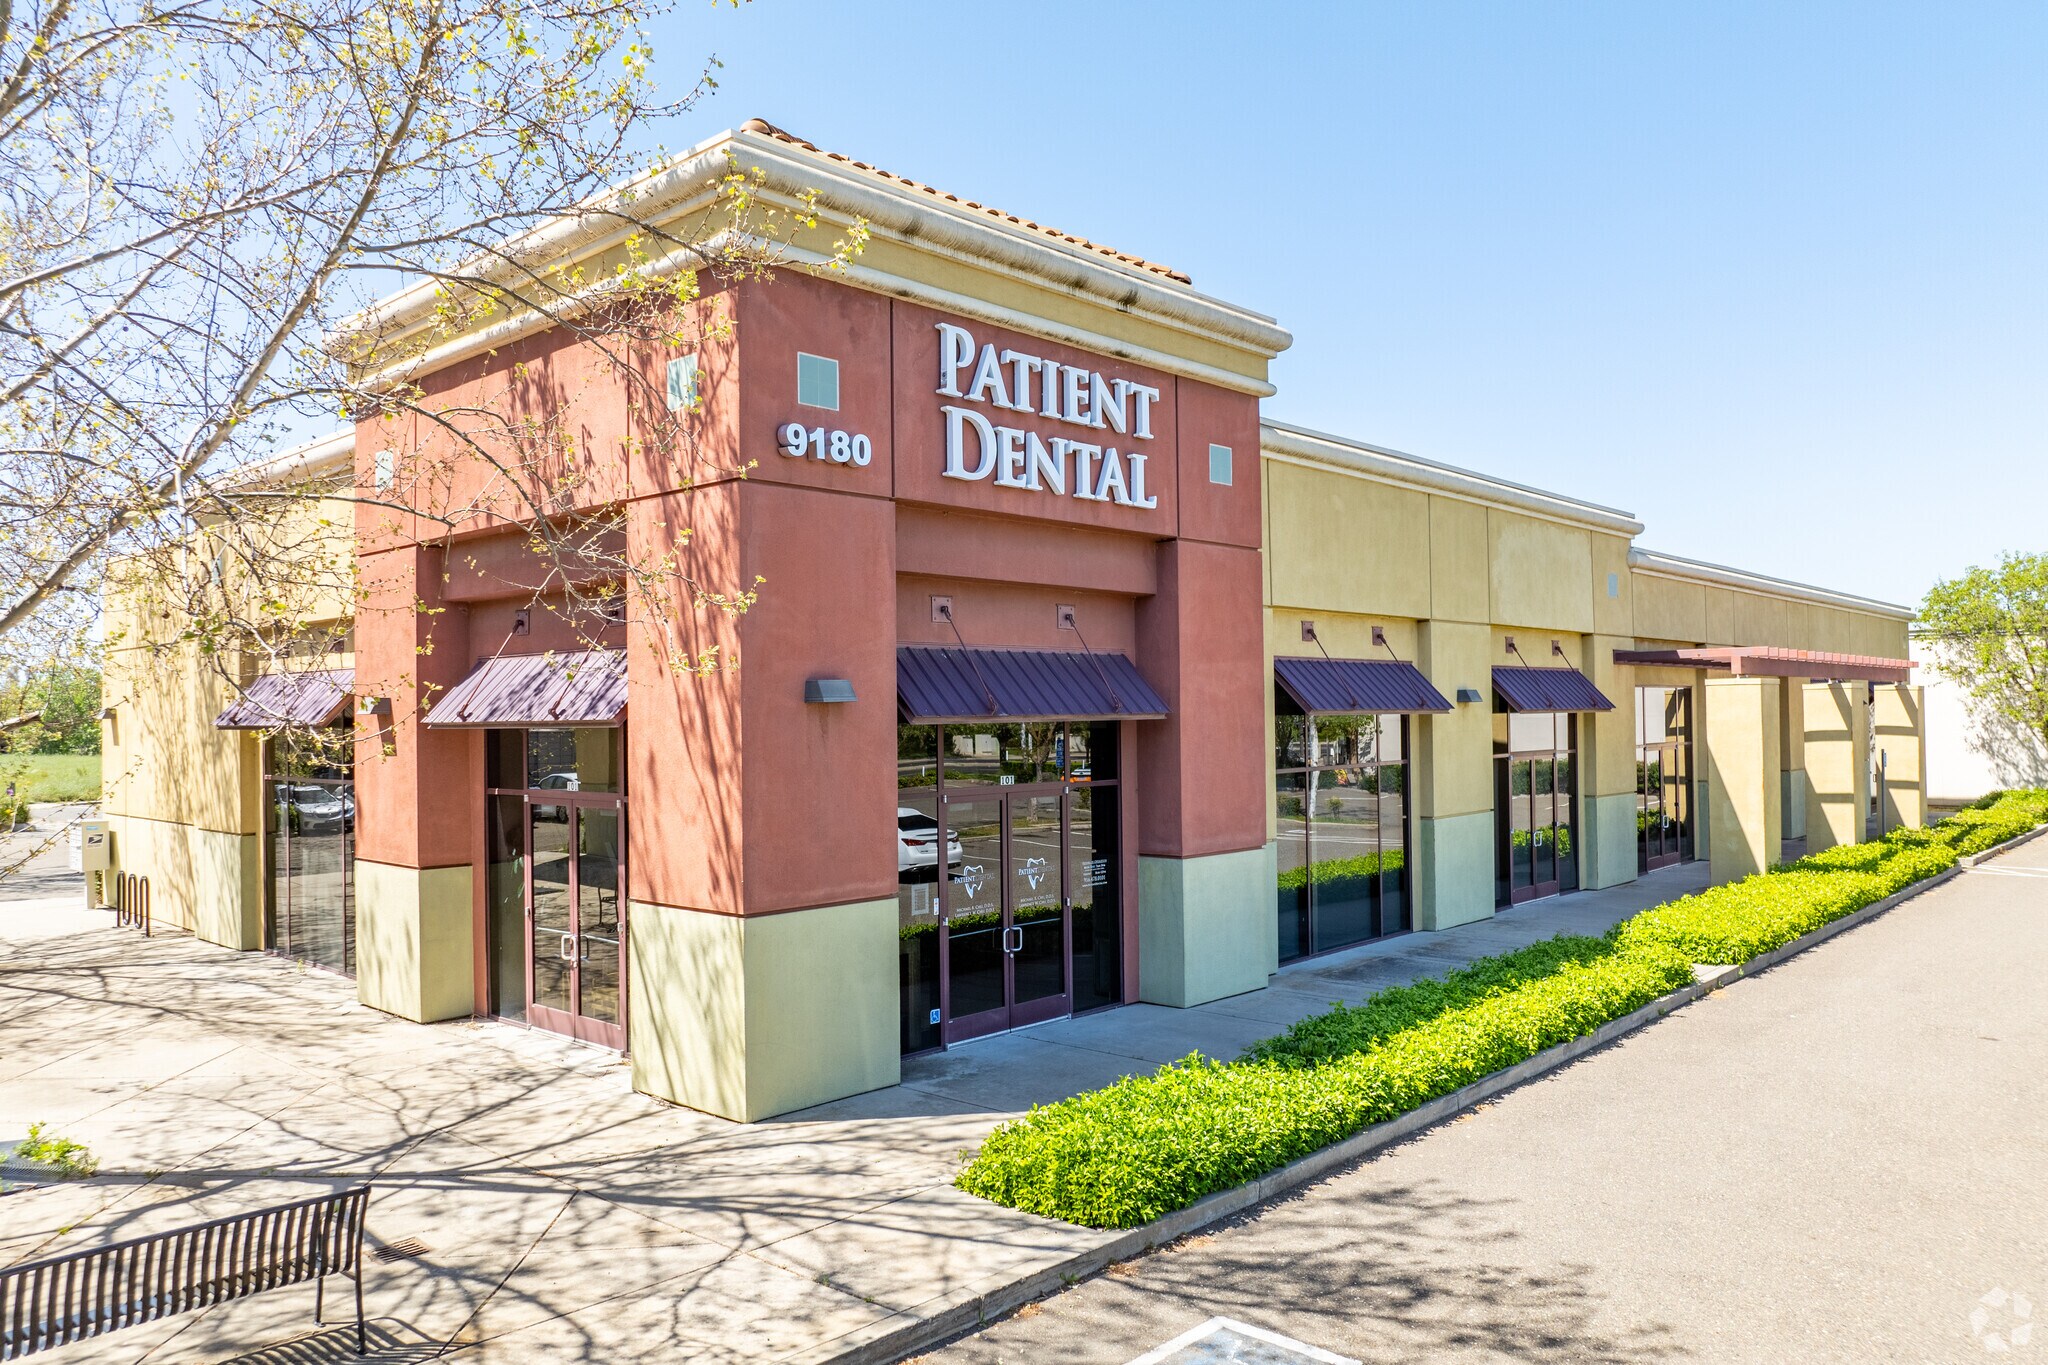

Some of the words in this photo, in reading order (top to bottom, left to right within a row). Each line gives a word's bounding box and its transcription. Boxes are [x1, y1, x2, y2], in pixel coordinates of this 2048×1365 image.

[935, 322, 1160, 440] PATIENT
[779, 423, 872, 467] 9180
[940, 405, 1158, 509] DENTAL
[1001, 776, 1014, 785] 101
[954, 875, 976, 884] PATIENT
[1018, 867, 1038, 876] PATIENT
